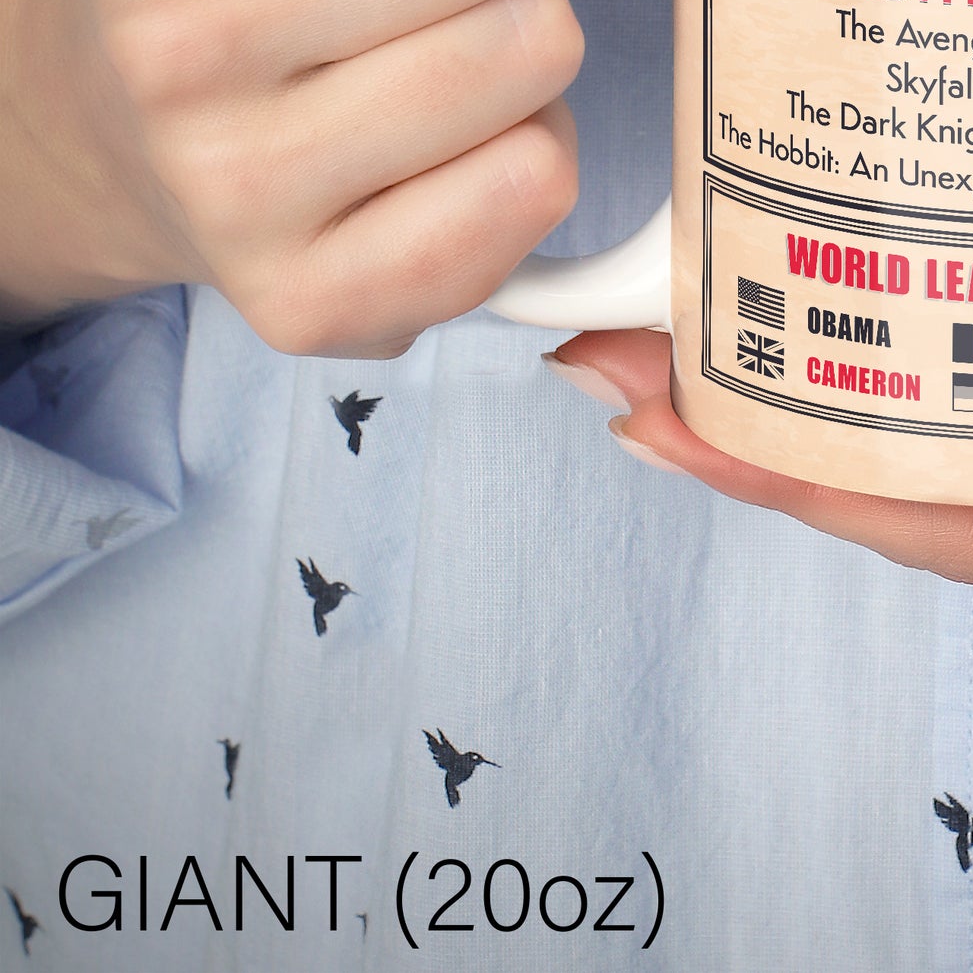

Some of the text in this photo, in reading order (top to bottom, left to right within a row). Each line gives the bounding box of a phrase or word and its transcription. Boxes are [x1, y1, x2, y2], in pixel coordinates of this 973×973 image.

[836, 8, 885, 44] The
[786, 89, 831, 127] The
[841, 101, 907, 140] Dark
[719, 112, 752, 149] The
[759, 128, 840, 174] Hobbit:
[850, 151, 888, 182] An
[787, 233, 910, 295] WORLD
[807, 306, 892, 348] OBAMA
[807, 356, 921, 402] CAMERON
